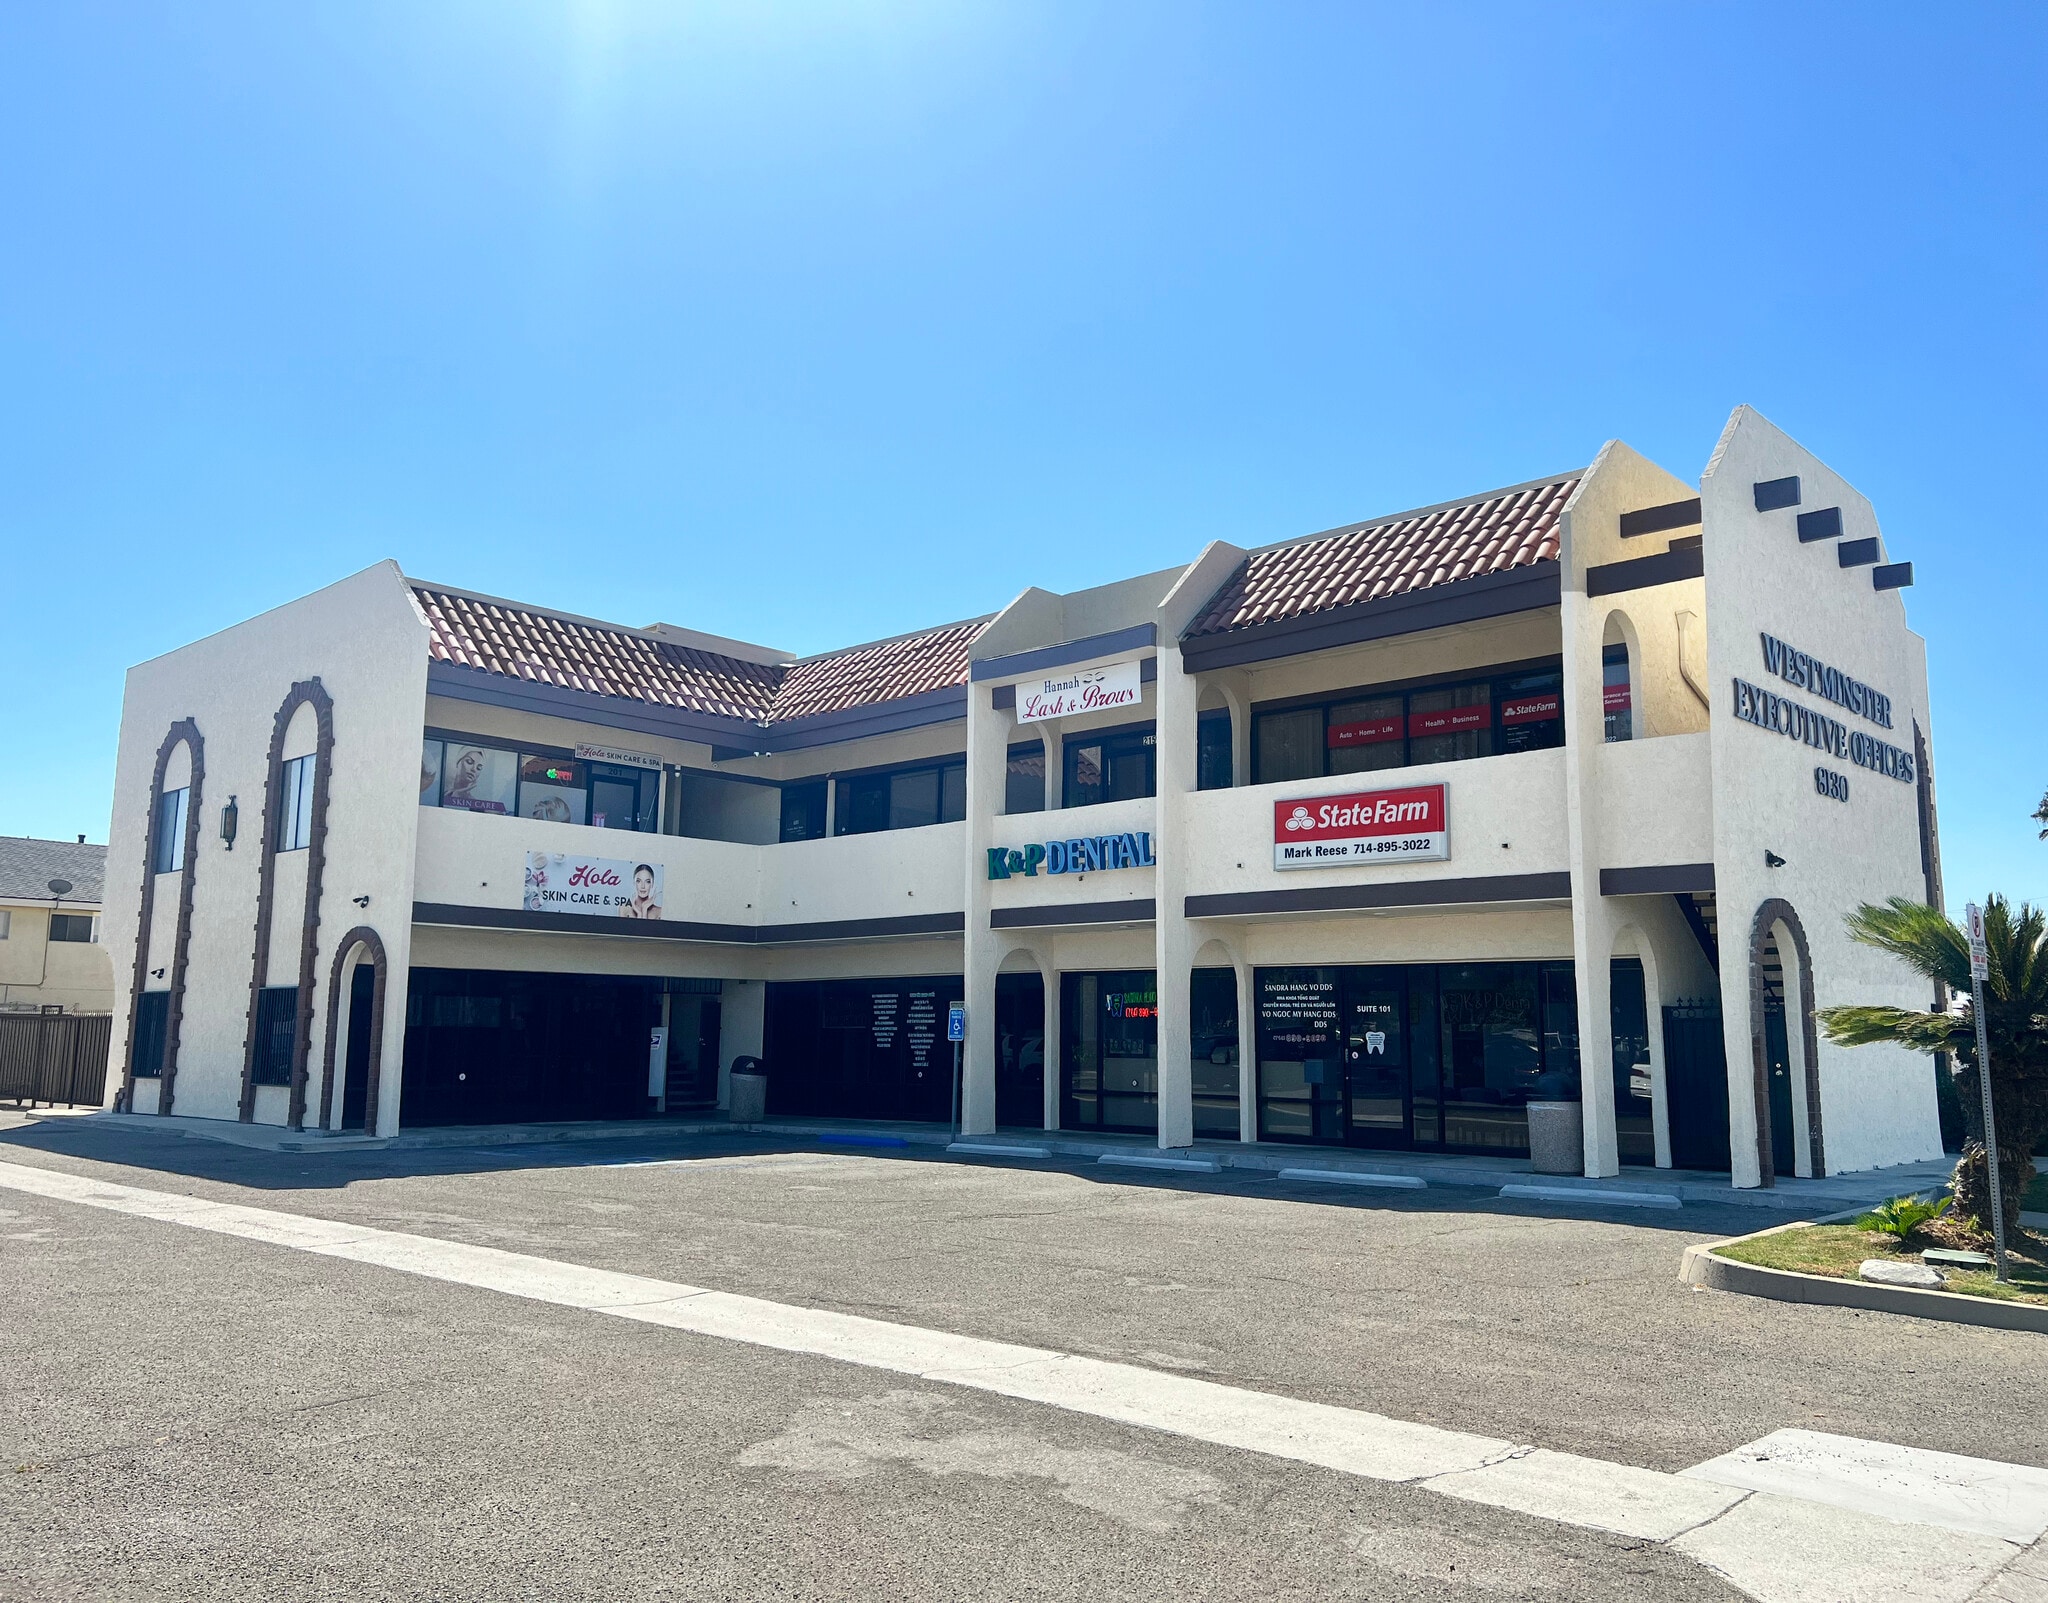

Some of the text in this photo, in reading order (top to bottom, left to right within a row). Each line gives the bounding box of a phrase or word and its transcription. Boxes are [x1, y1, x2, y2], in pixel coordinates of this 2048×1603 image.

[1044, 675, 1080, 694] Hannah
[1761, 631, 1894, 730] WESTMINSTER
[1022, 684, 1134, 719] Lash & Brows
[1425, 714, 1480, 728] Health Business
[1339, 725, 1394, 739] Auto Home Life
[1733, 677, 1916, 784] EXECUTIVE OFFICES
[582, 747, 605, 758] Hola
[606, 752, 622, 760] SKIN
[623, 755, 641, 764] CARE
[608, 767, 623, 777] 201
[452, 798, 496, 810] SKIN CARE
[987, 832, 1157, 880] K&P DENTAL
[1284, 839, 1430, 859] Mark Reese 714-895-3022
[568, 864, 622, 888] Hola
[542, 890, 633, 908] SKIN CARE & SPA
[1264, 984, 1289, 992] SANDRA
[1320, 983, 1333, 991] DDS
[1356, 1005, 1391, 1013] SUITE 101
